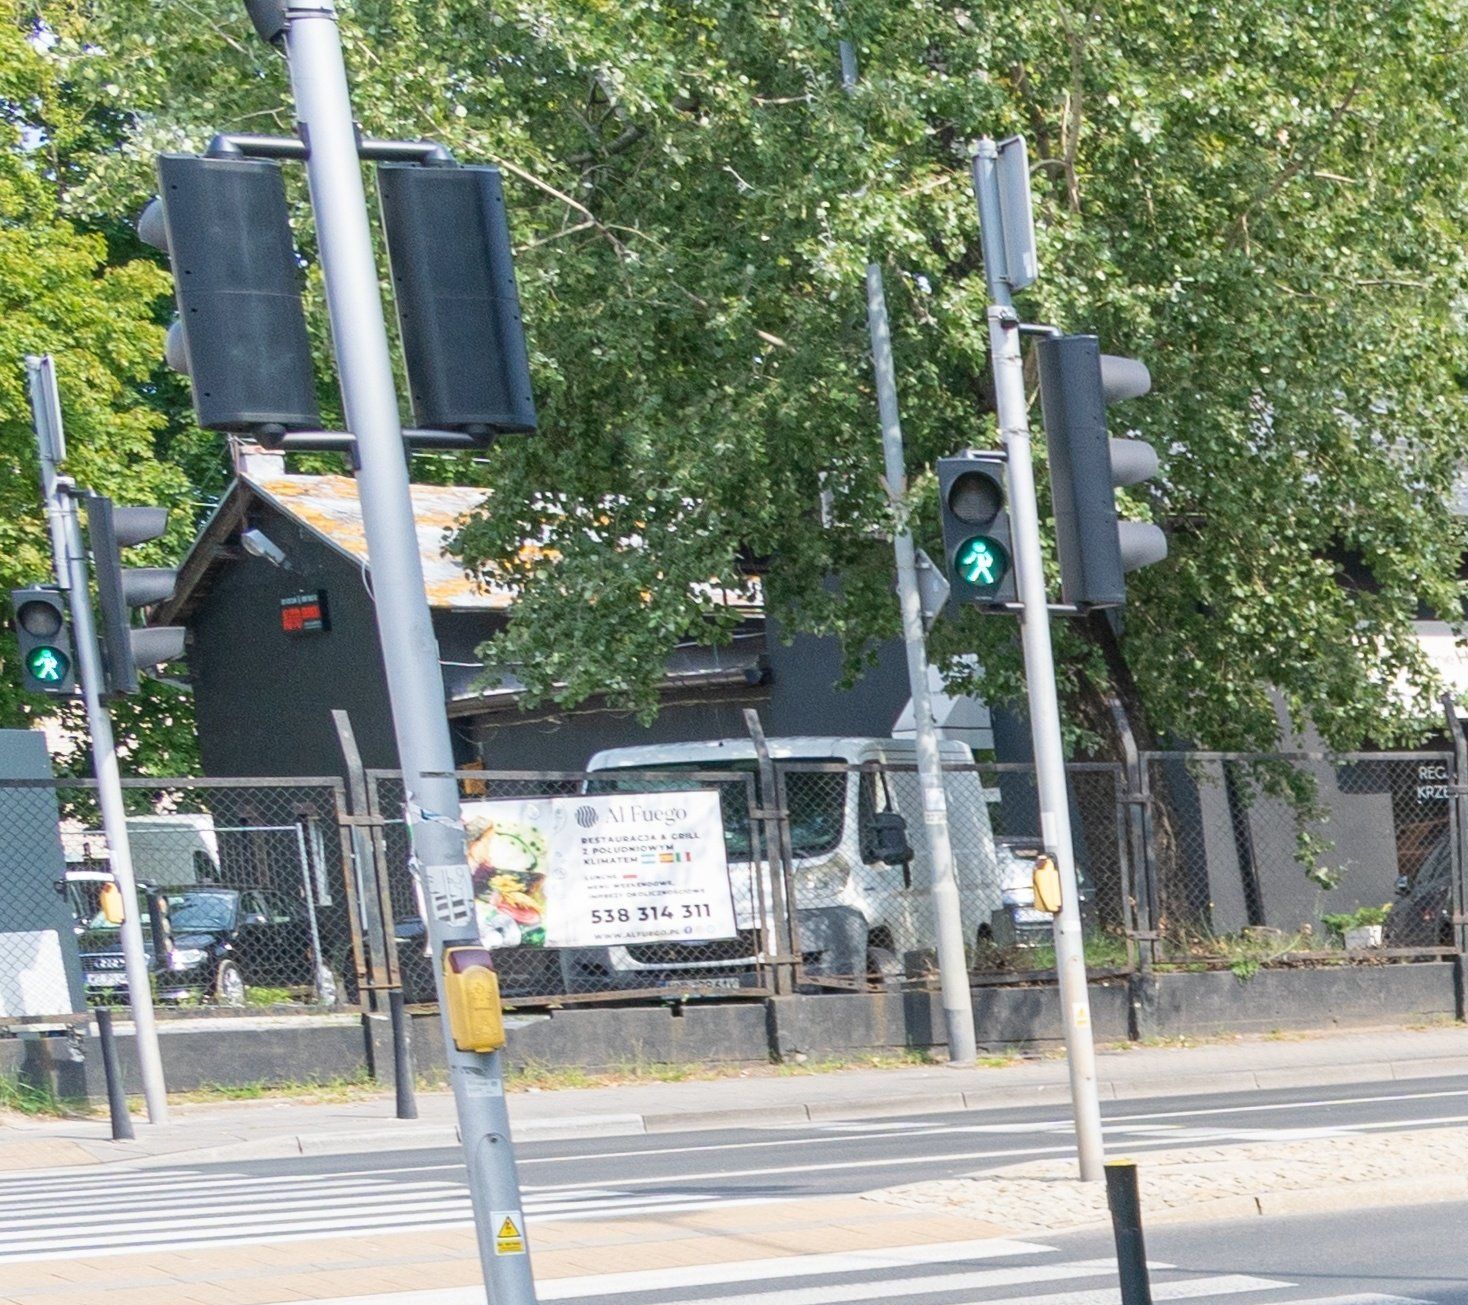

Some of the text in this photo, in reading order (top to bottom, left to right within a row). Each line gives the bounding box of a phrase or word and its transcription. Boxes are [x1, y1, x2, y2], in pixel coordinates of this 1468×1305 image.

[606, 805, 687, 826] Al Fuego
[581, 834, 657, 845] RESTAURACJA
[591, 904, 712, 924] 538 314 311
